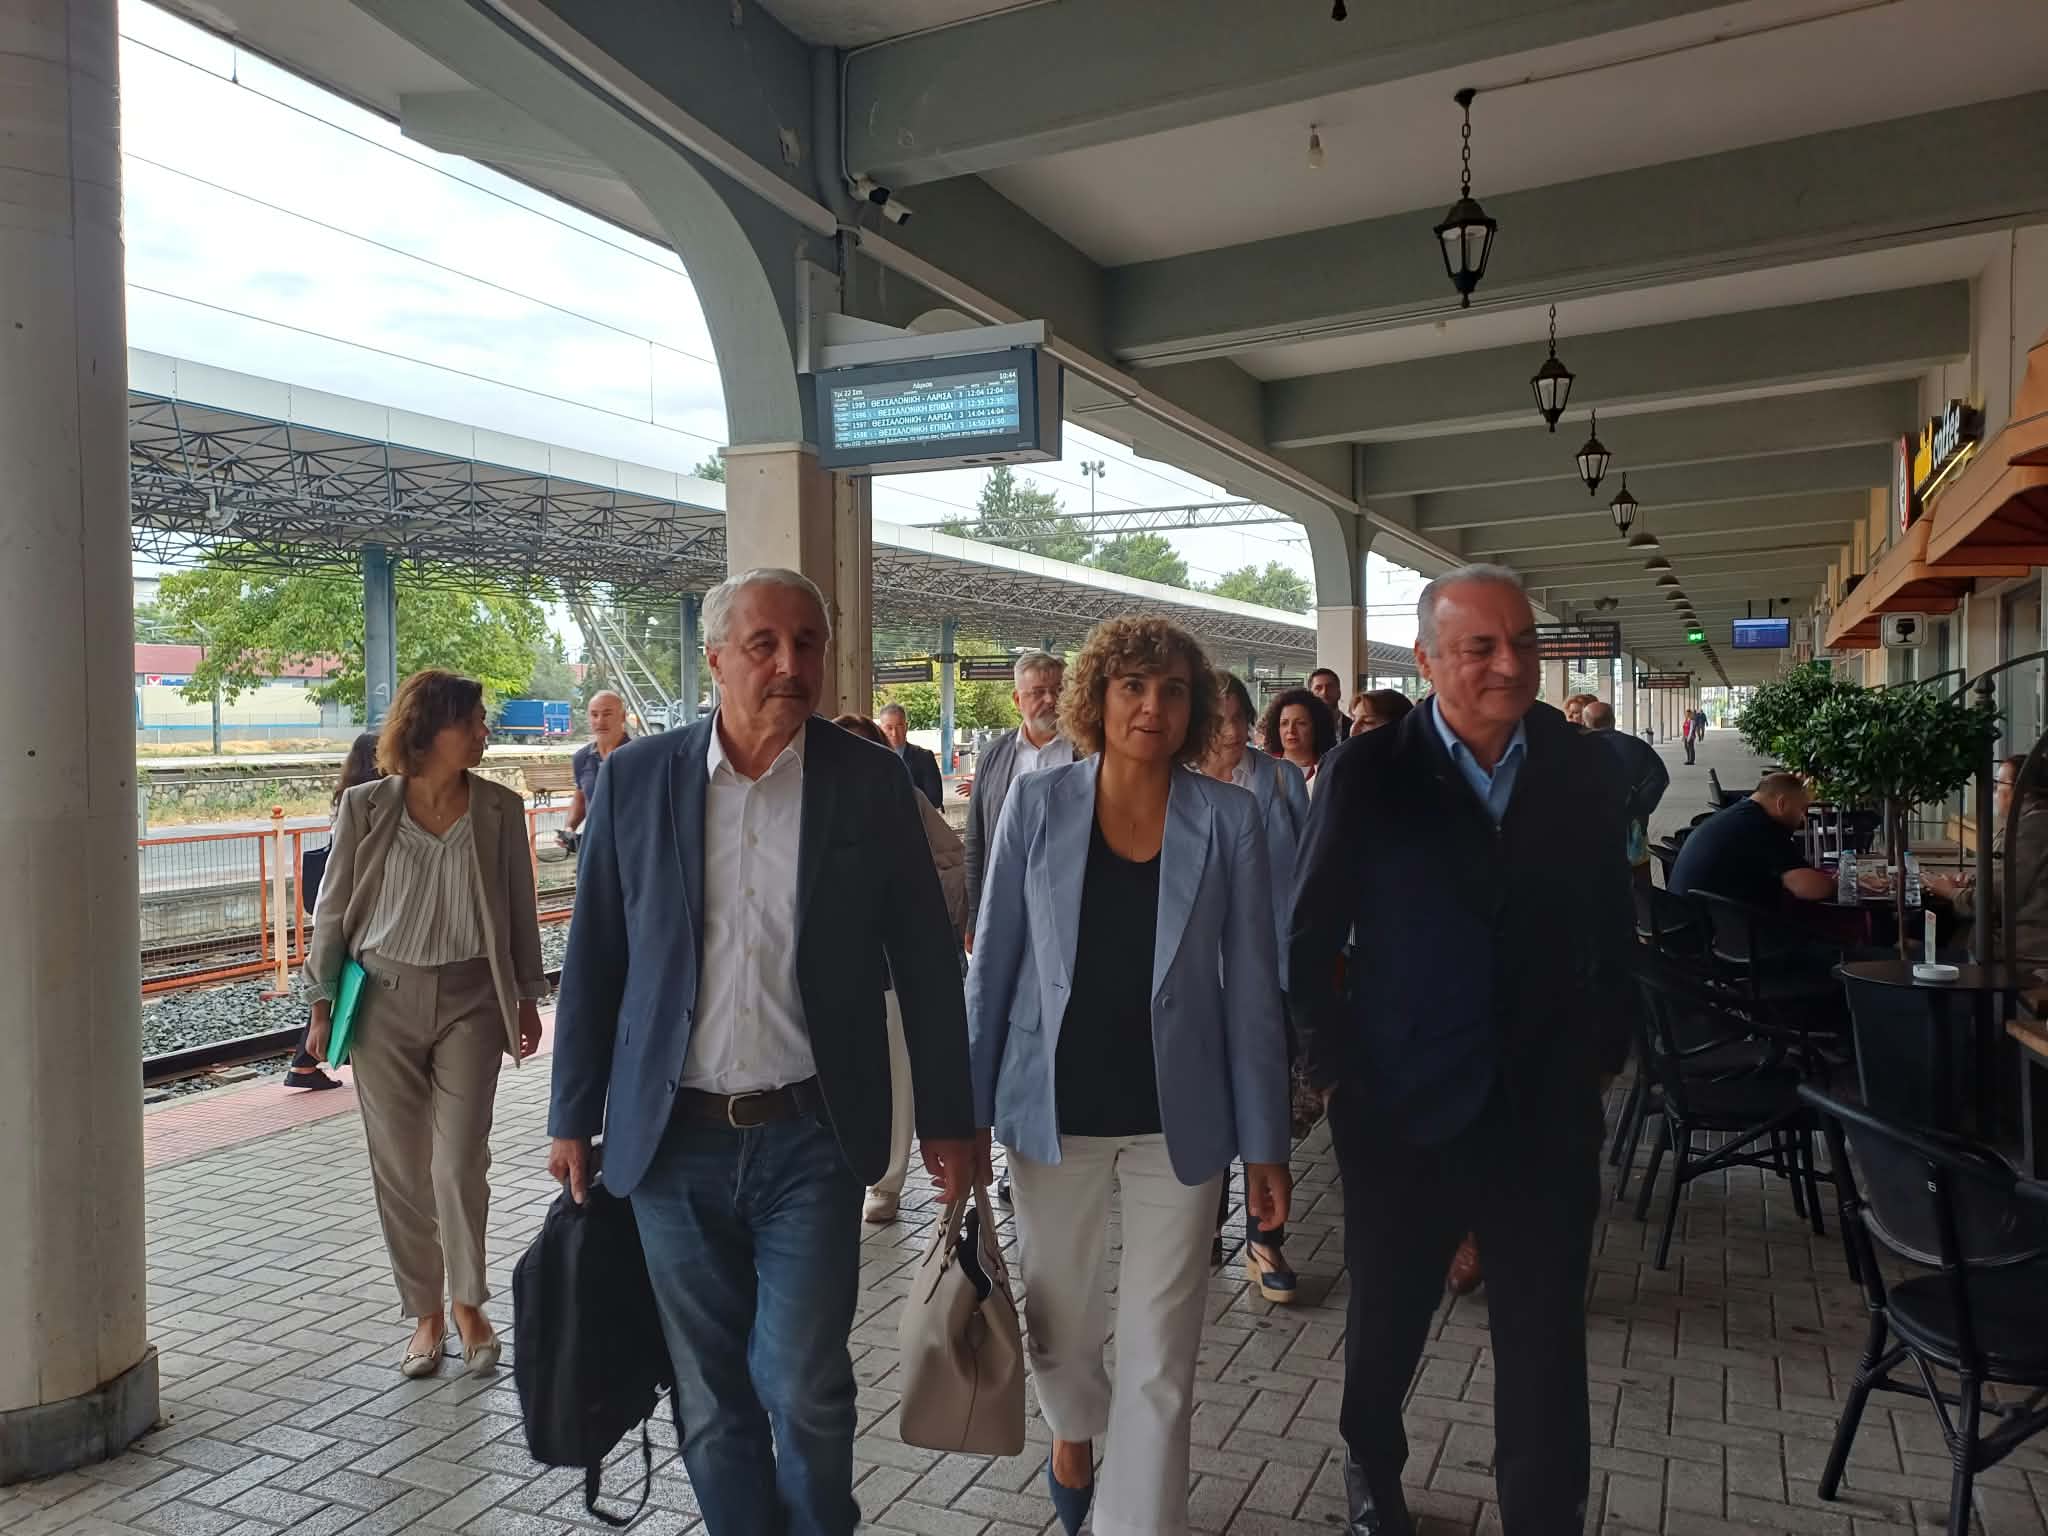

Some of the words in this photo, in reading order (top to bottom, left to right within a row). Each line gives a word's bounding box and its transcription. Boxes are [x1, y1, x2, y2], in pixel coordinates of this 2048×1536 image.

[999, 371, 1015, 379] 10:44
[870, 395, 920, 407] ΘΕΣΣΑΛΟΝΙΚΗ
[926, 391, 952, 401] ΛΑΡΙΣΑ
[871, 415, 921, 427] ΘΕΣΣΑΛΟΝΙΚΗ
[927, 412, 952, 421] ΛΑΡΙΣΑ
[1932, 400, 1960, 470] coffee
